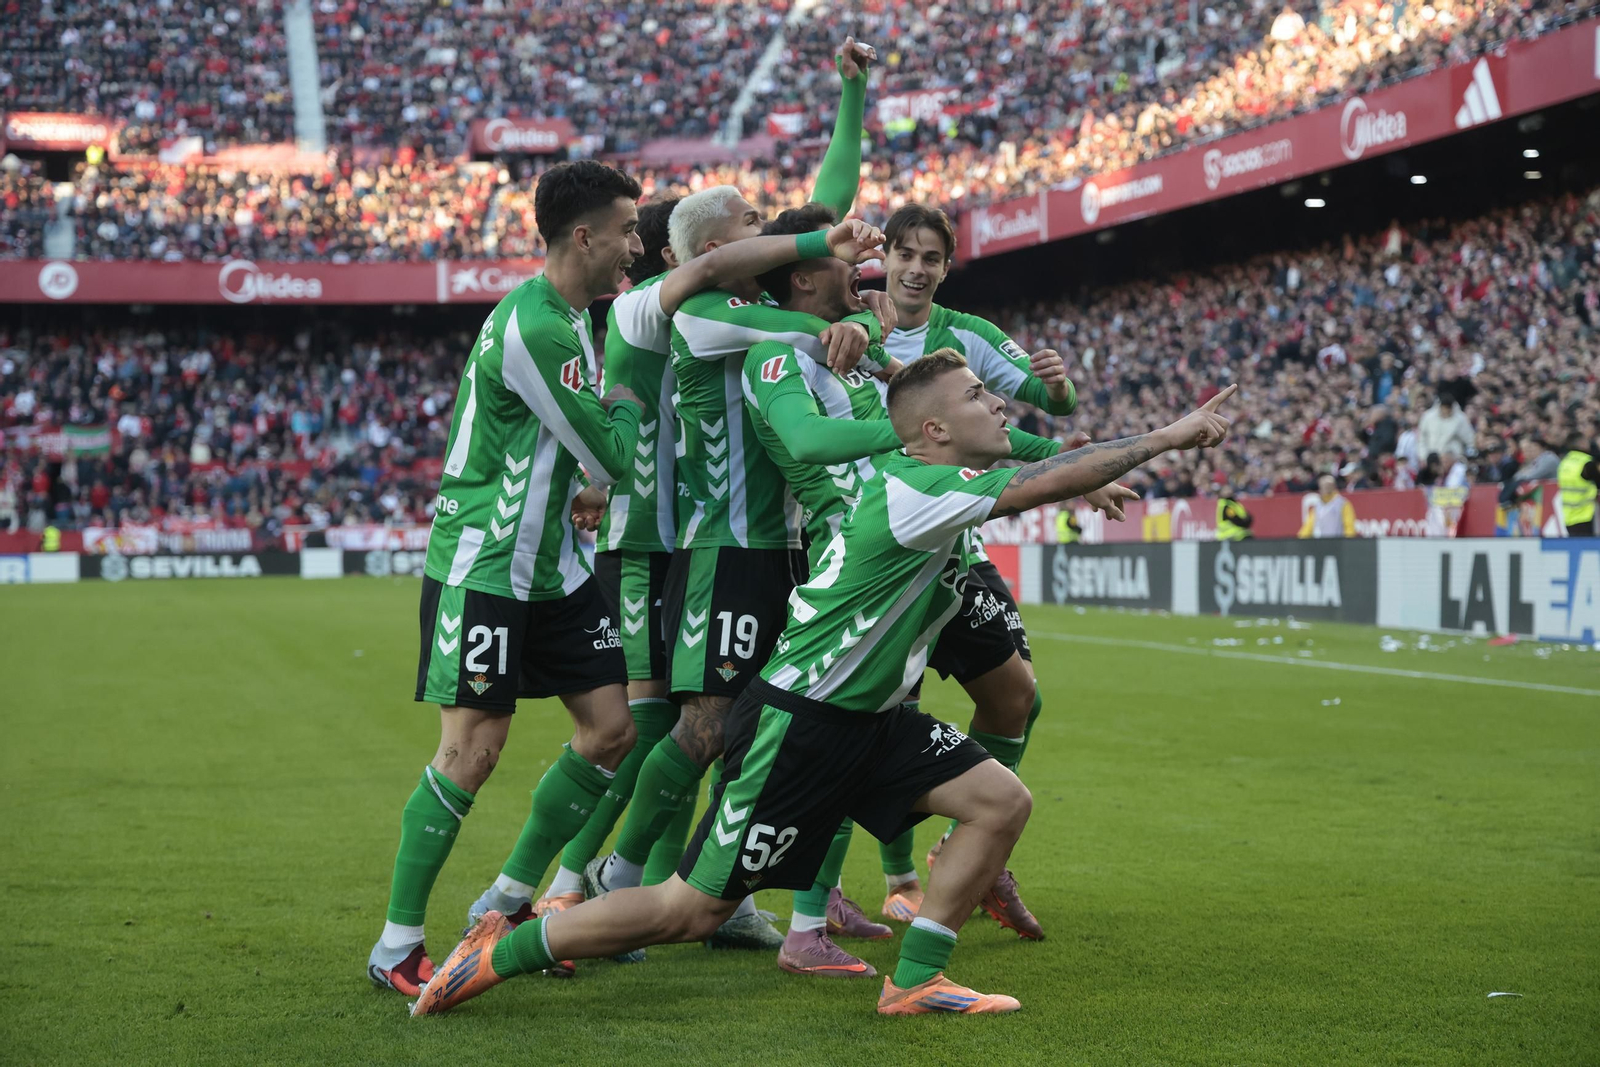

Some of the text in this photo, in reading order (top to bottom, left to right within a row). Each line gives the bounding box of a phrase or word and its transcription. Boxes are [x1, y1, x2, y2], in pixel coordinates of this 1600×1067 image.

[219, 260, 323, 303] Midea
[465, 625, 508, 675] 21
[717, 611, 758, 659] 19
[741, 823, 798, 871] 52
